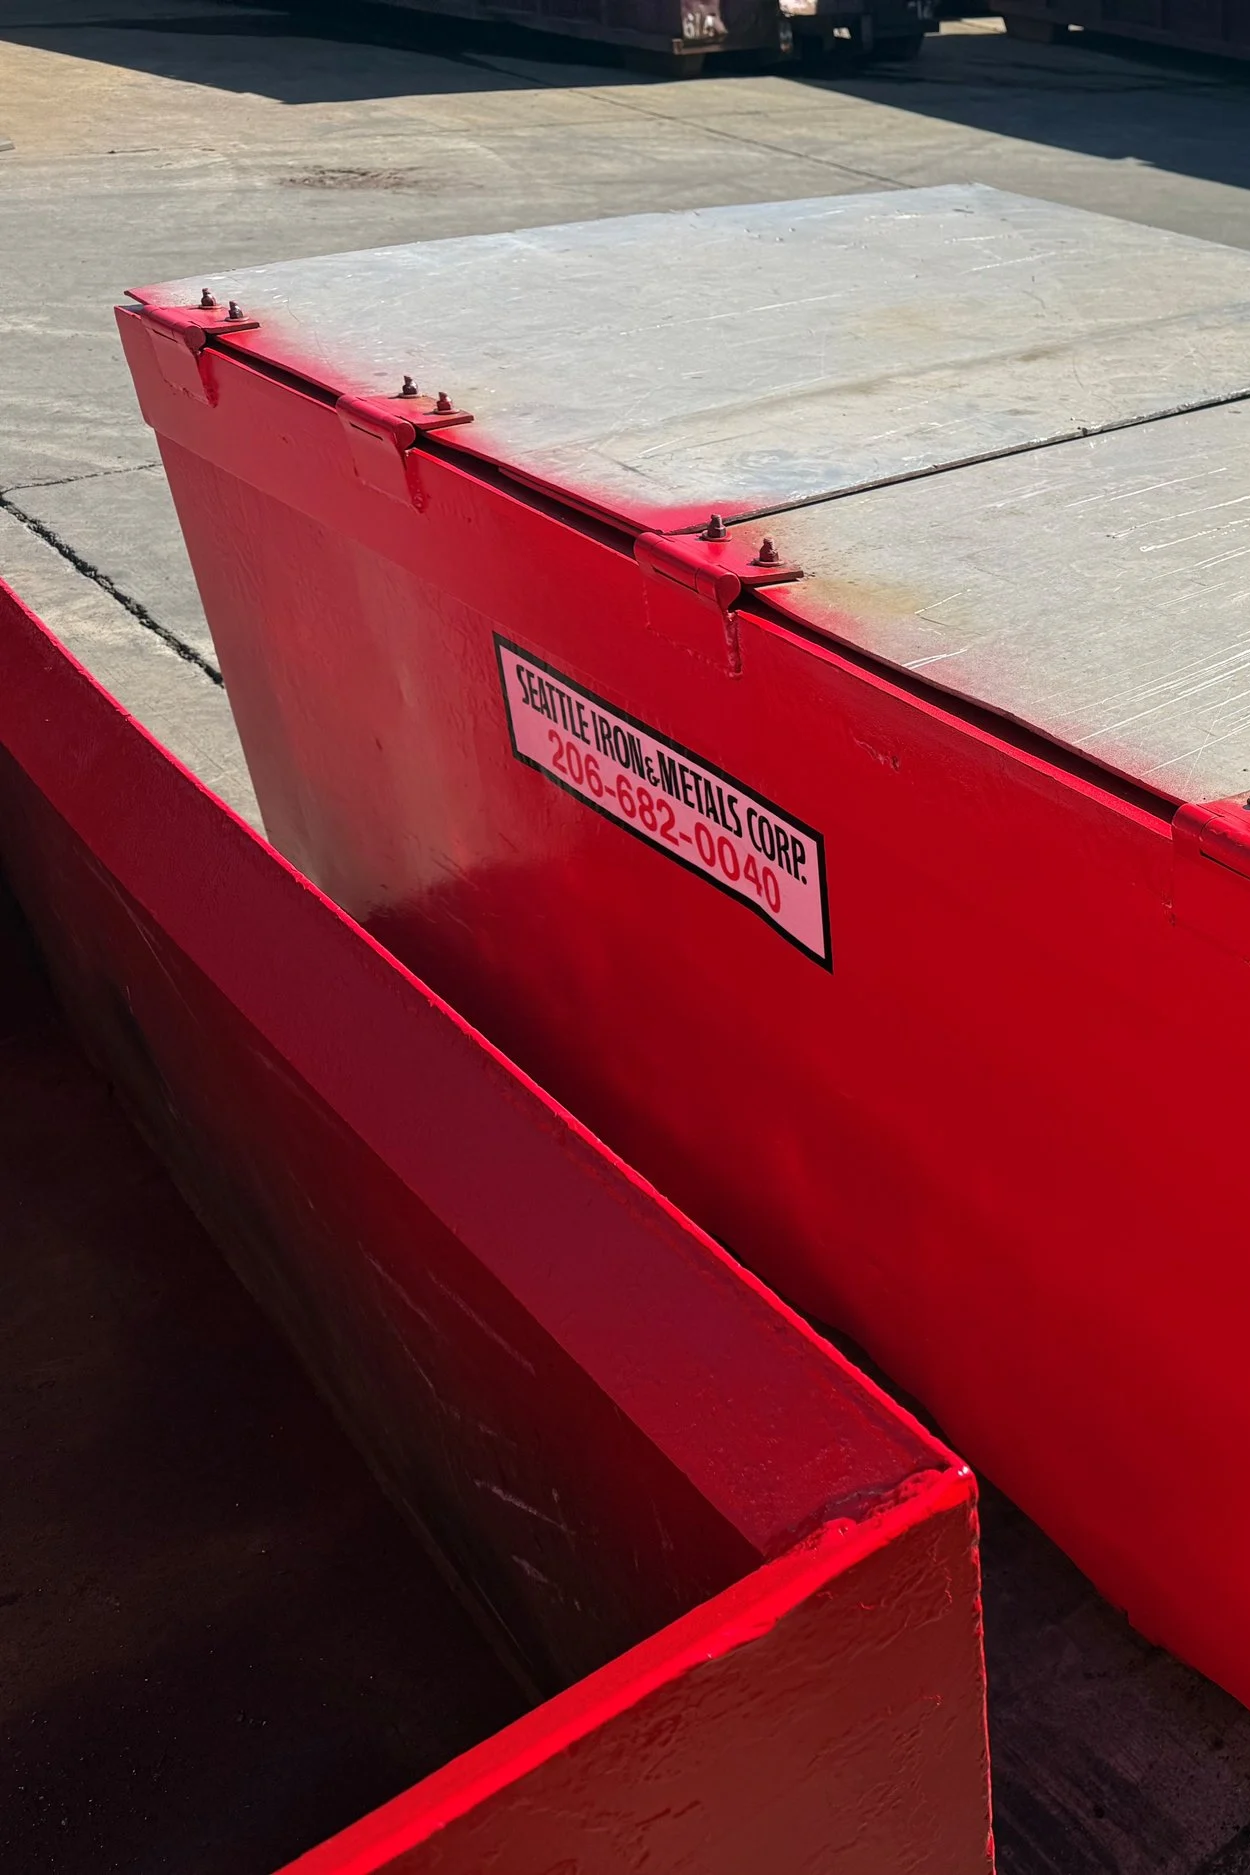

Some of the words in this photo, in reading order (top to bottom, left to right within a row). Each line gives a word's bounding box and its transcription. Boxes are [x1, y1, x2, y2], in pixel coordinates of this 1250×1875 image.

[516, 663, 591, 744] SEATTLE
[746, 807, 808, 885] CORP.
[548, 729, 781, 914] 206-682-0040
